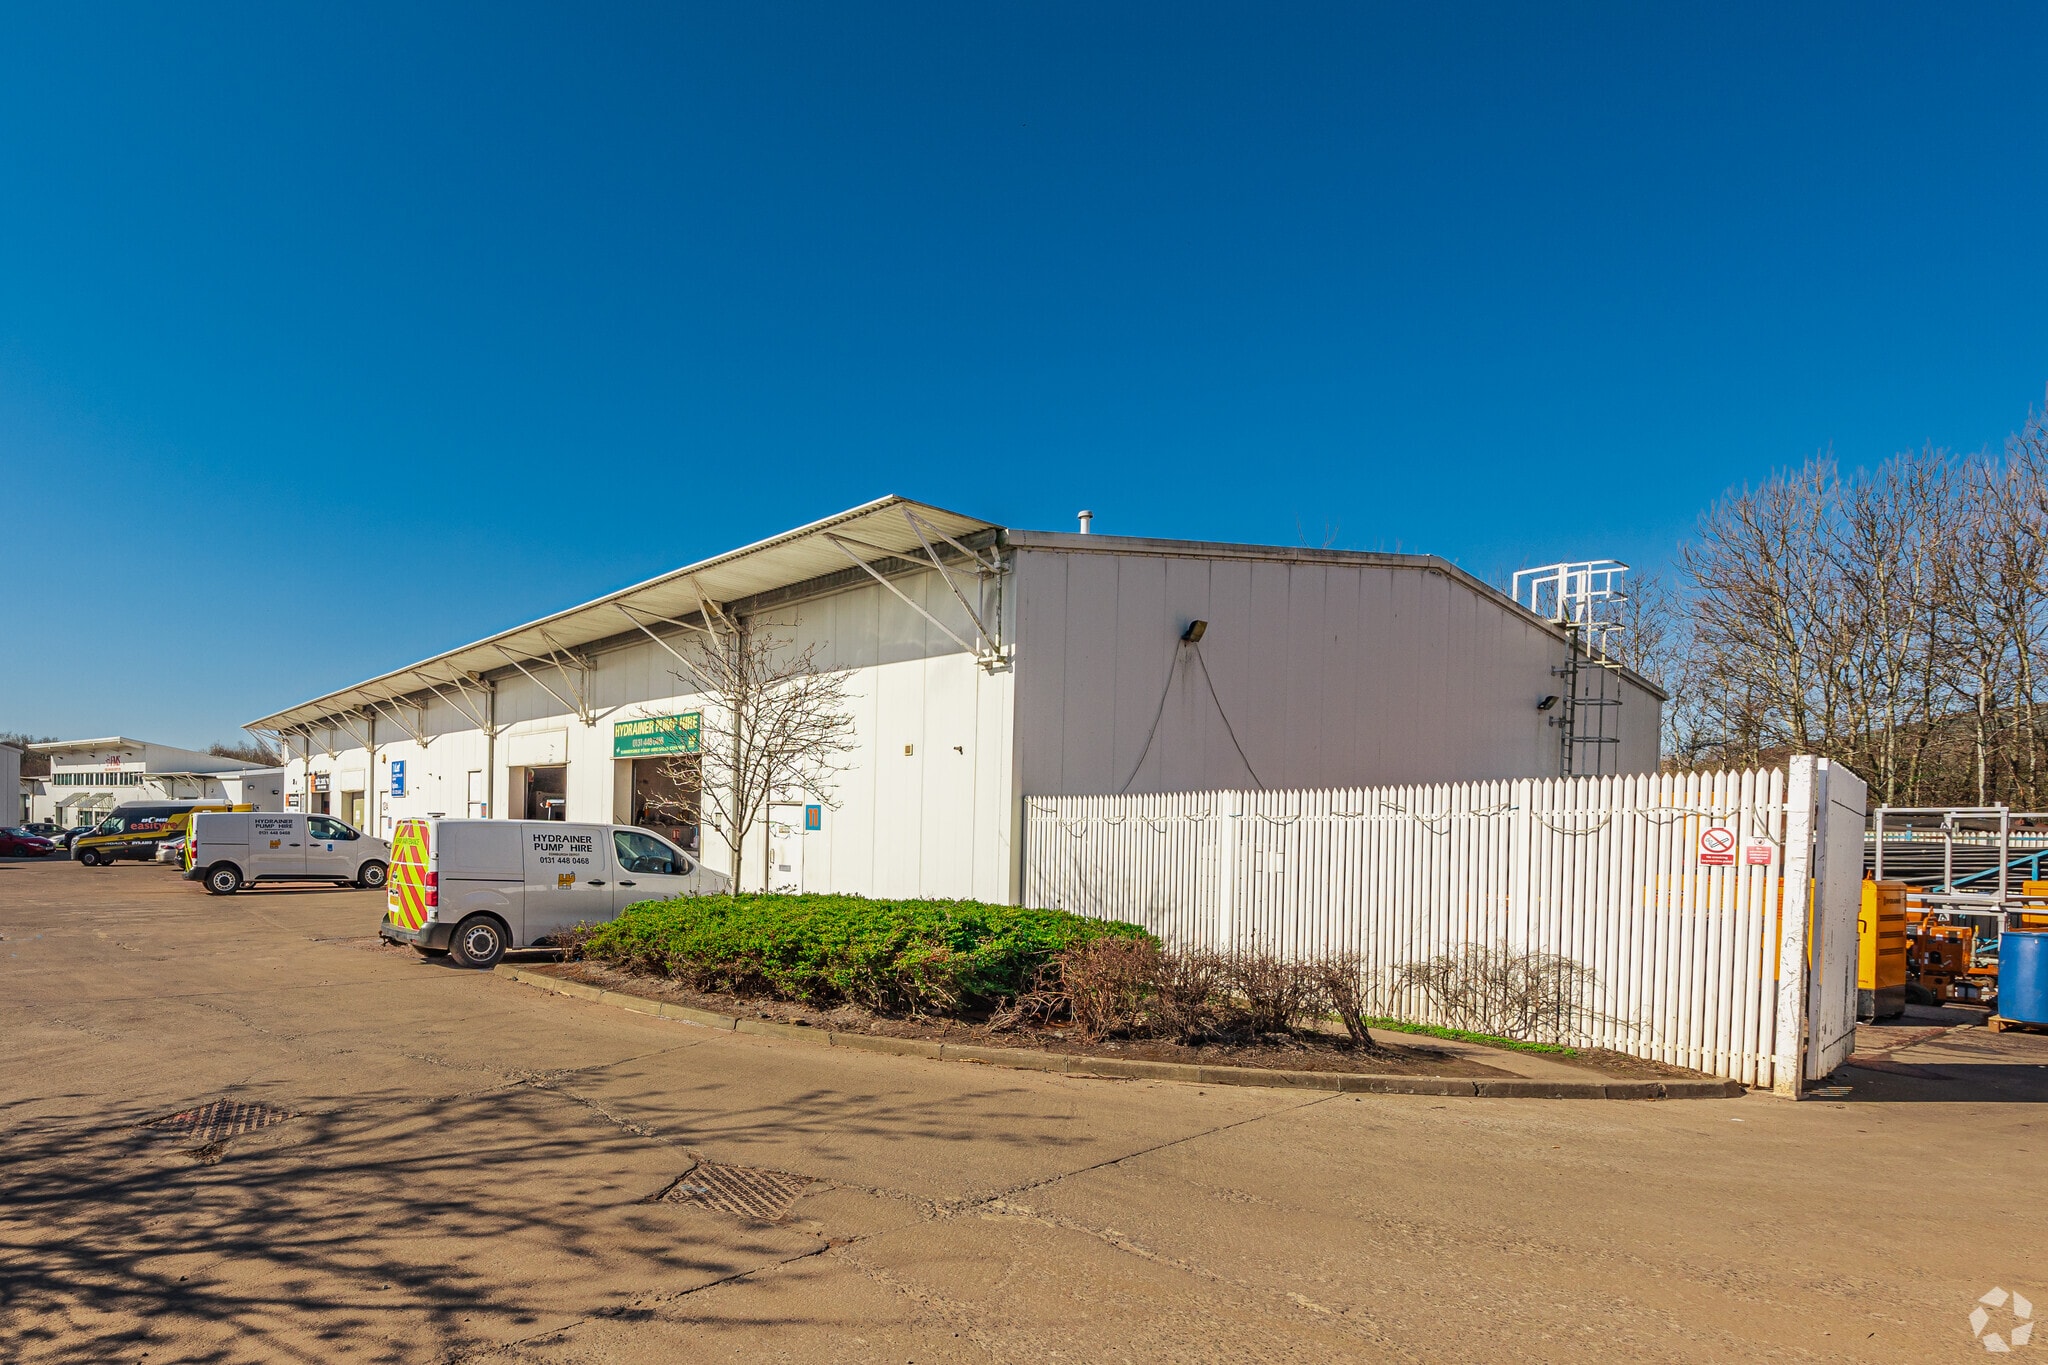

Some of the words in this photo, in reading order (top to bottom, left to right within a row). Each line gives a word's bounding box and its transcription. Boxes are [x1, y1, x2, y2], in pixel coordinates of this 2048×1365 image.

[615, 720, 654, 737] HYDRAINER
[656, 717, 678, 733] PUMP
[679, 715, 698, 730] HIRE
[808, 808, 818, 826] 11
[130, 822, 178, 832] easityre
[533, 834, 592, 844] HYDRAINER
[534, 843, 564, 851] PUMP
[570, 844, 593, 852] HIRE
[572, 857, 590, 865] 0468
